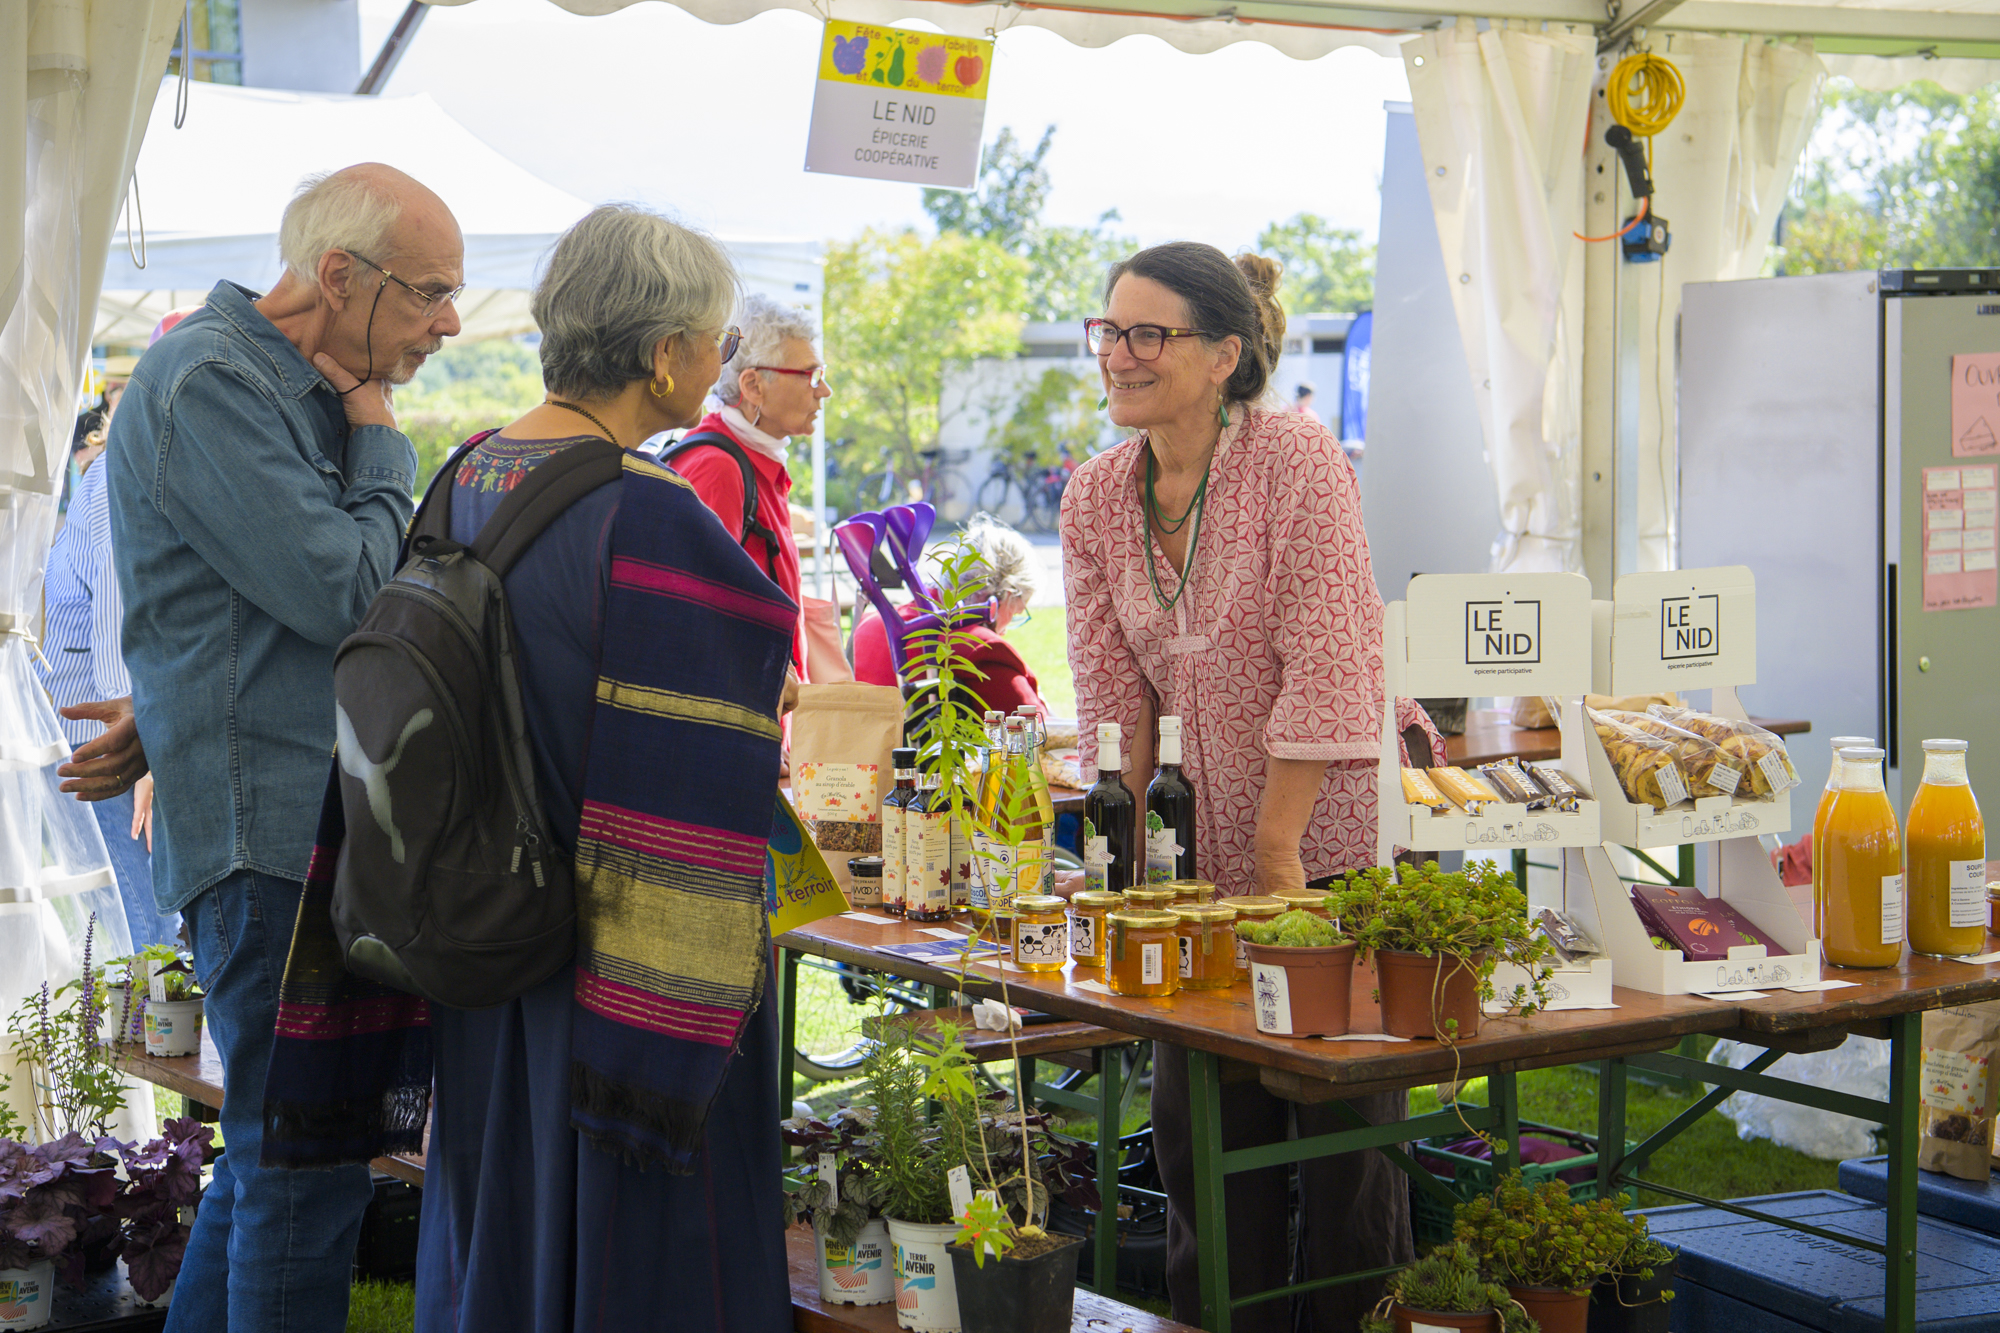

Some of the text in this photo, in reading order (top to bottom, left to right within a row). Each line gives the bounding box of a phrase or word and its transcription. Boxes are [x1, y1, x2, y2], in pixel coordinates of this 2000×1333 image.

[856, 26, 881, 40] Fête
[907, 34, 920, 45] de
[856, 71, 868, 81] et
[906, 77, 919, 88] du
[873, 100, 935, 125] LE NID
[872, 127, 929, 149] ÉPICERIE
[854, 147, 939, 170] COOPÉRATIVE
[1474, 610, 1503, 631] LE
[1668, 605, 1690, 628] LE
[1485, 633, 1533, 656] NID
[1676, 627, 1713, 651] NID
[1474, 667, 1533, 676] épicerie participative
[1667, 661, 1713, 671] épicerie participative
[1503, 764, 1540, 795] PANFORTE
[510, 846, 522, 873] PUMA
[532, 861, 545, 887] PUMA
[786, 877, 834, 902] terroir
[857, 1249, 881, 1259] AVENIR
[909, 1252, 927, 1262] TERRE
[906, 1260, 935, 1275] AVENIR
[19, 1285, 39, 1294] AVENIR
